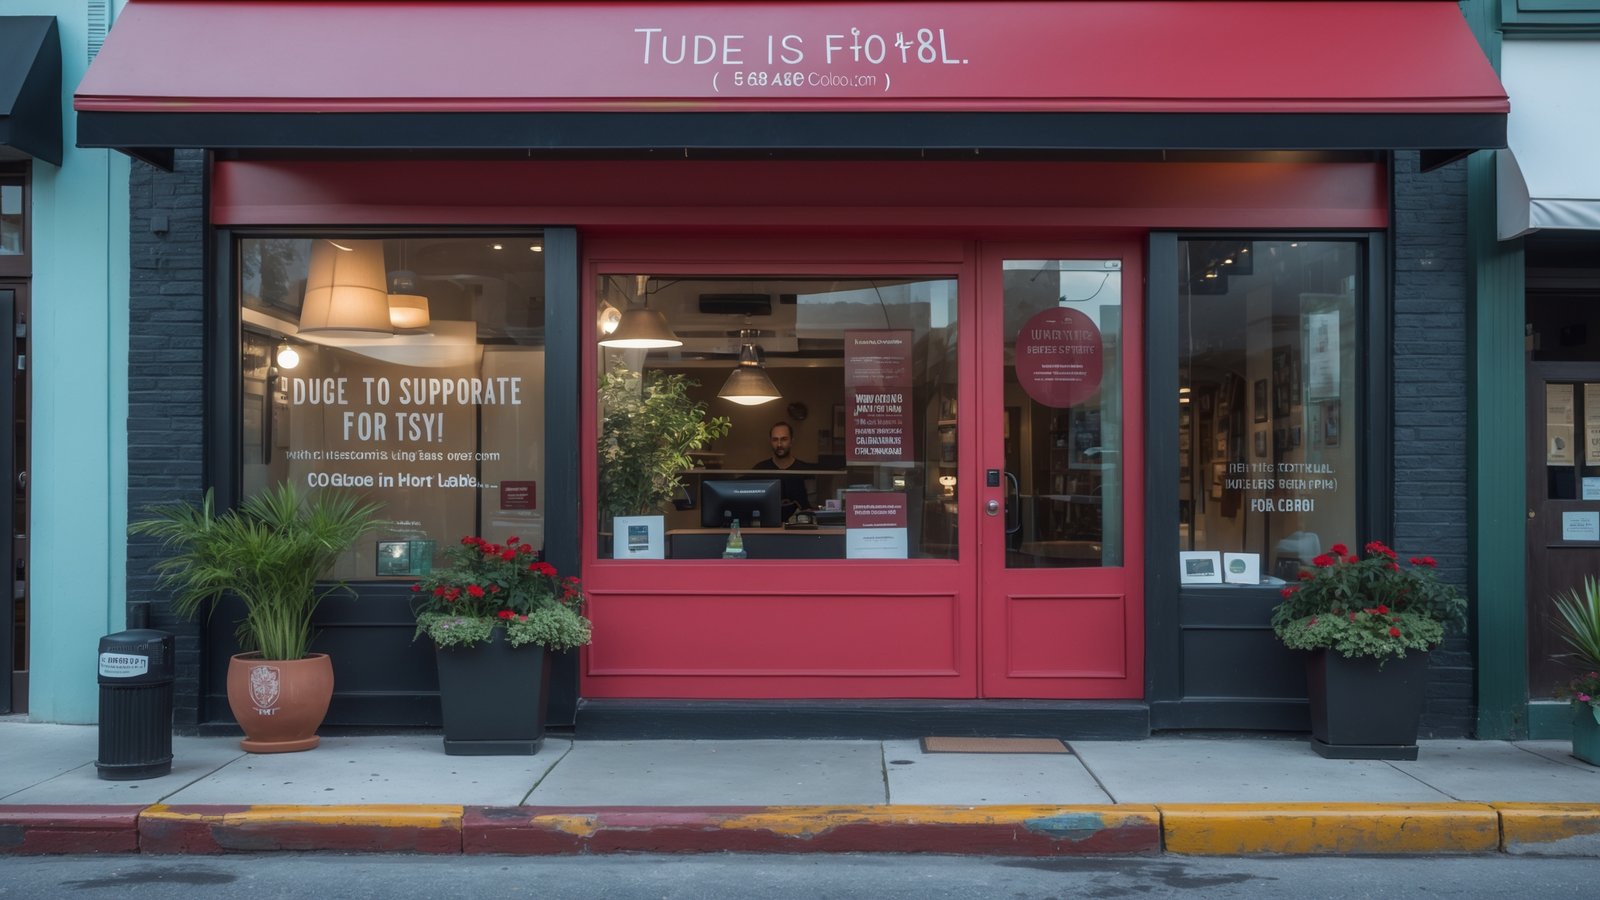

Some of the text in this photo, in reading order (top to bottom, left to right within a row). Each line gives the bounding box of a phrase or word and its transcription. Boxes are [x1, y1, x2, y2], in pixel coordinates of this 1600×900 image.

[634, 28, 744, 64] TUDE
[768, 35, 803, 64] IS
[293, 377, 521, 405] DUGE TO SUPPORATE
[343, 412, 444, 442] FOR TSY!
[379, 472, 394, 487] in
